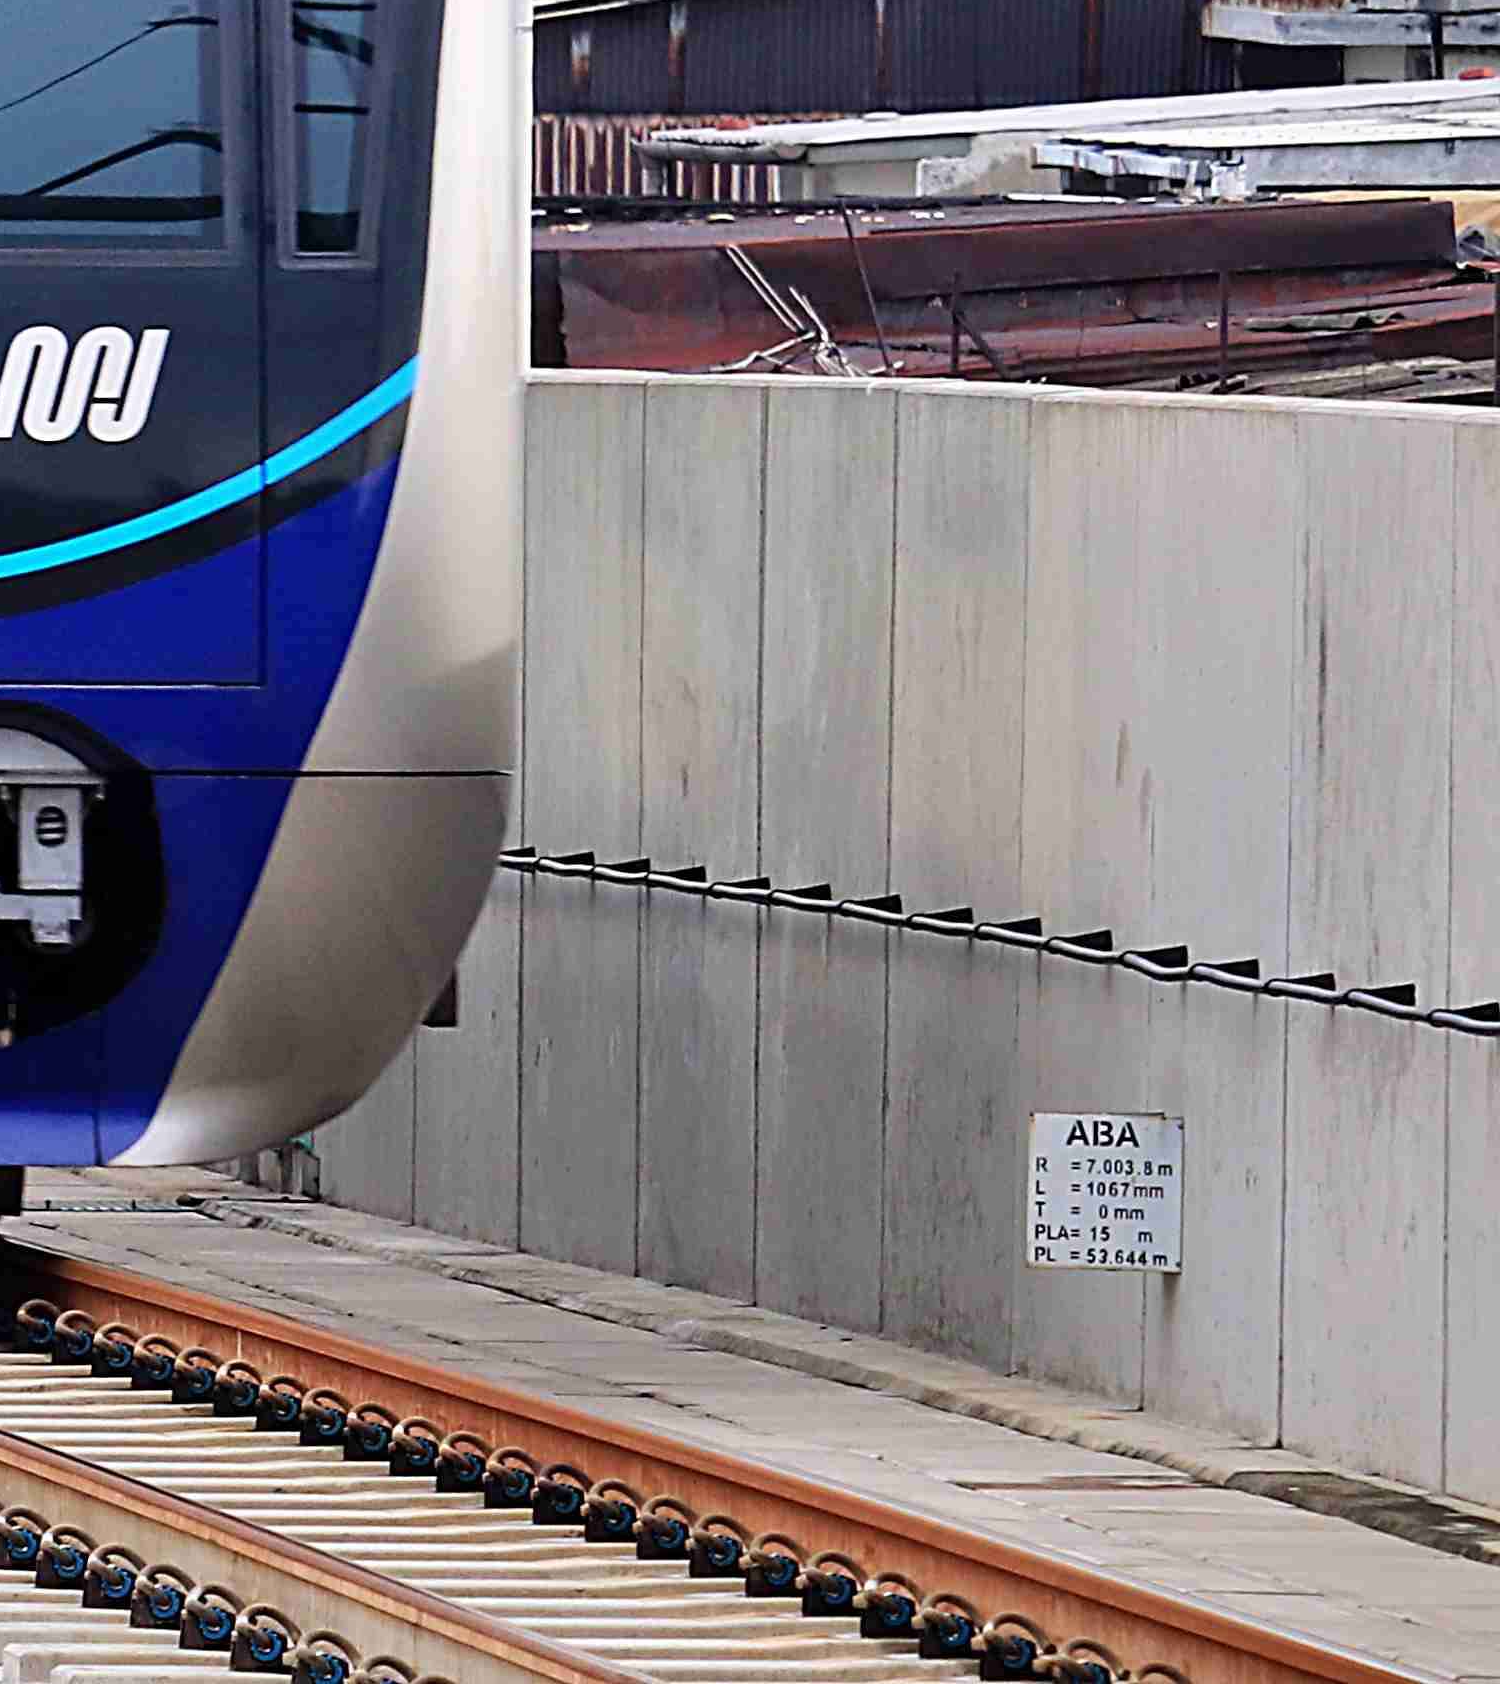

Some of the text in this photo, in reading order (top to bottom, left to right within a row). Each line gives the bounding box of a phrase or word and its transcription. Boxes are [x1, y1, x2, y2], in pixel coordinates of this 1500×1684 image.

[1066, 1120, 1140, 1148] ABA
[1036, 1157, 1048, 1172] R
[1036, 1180, 1045, 1195] L
[1036, 1202, 1046, 1217] T
[1099, 1205, 1108, 1220] 0
[1114, 1208, 1144, 1220] mm
[1091, 1226, 1110, 1242] 15
[1138, 1231, 1153, 1243] m
[1035, 1247, 1056, 1262] PL
[1087, 1248, 1147, 1265] 53.644
[1153, 1254, 1168, 1267] m
